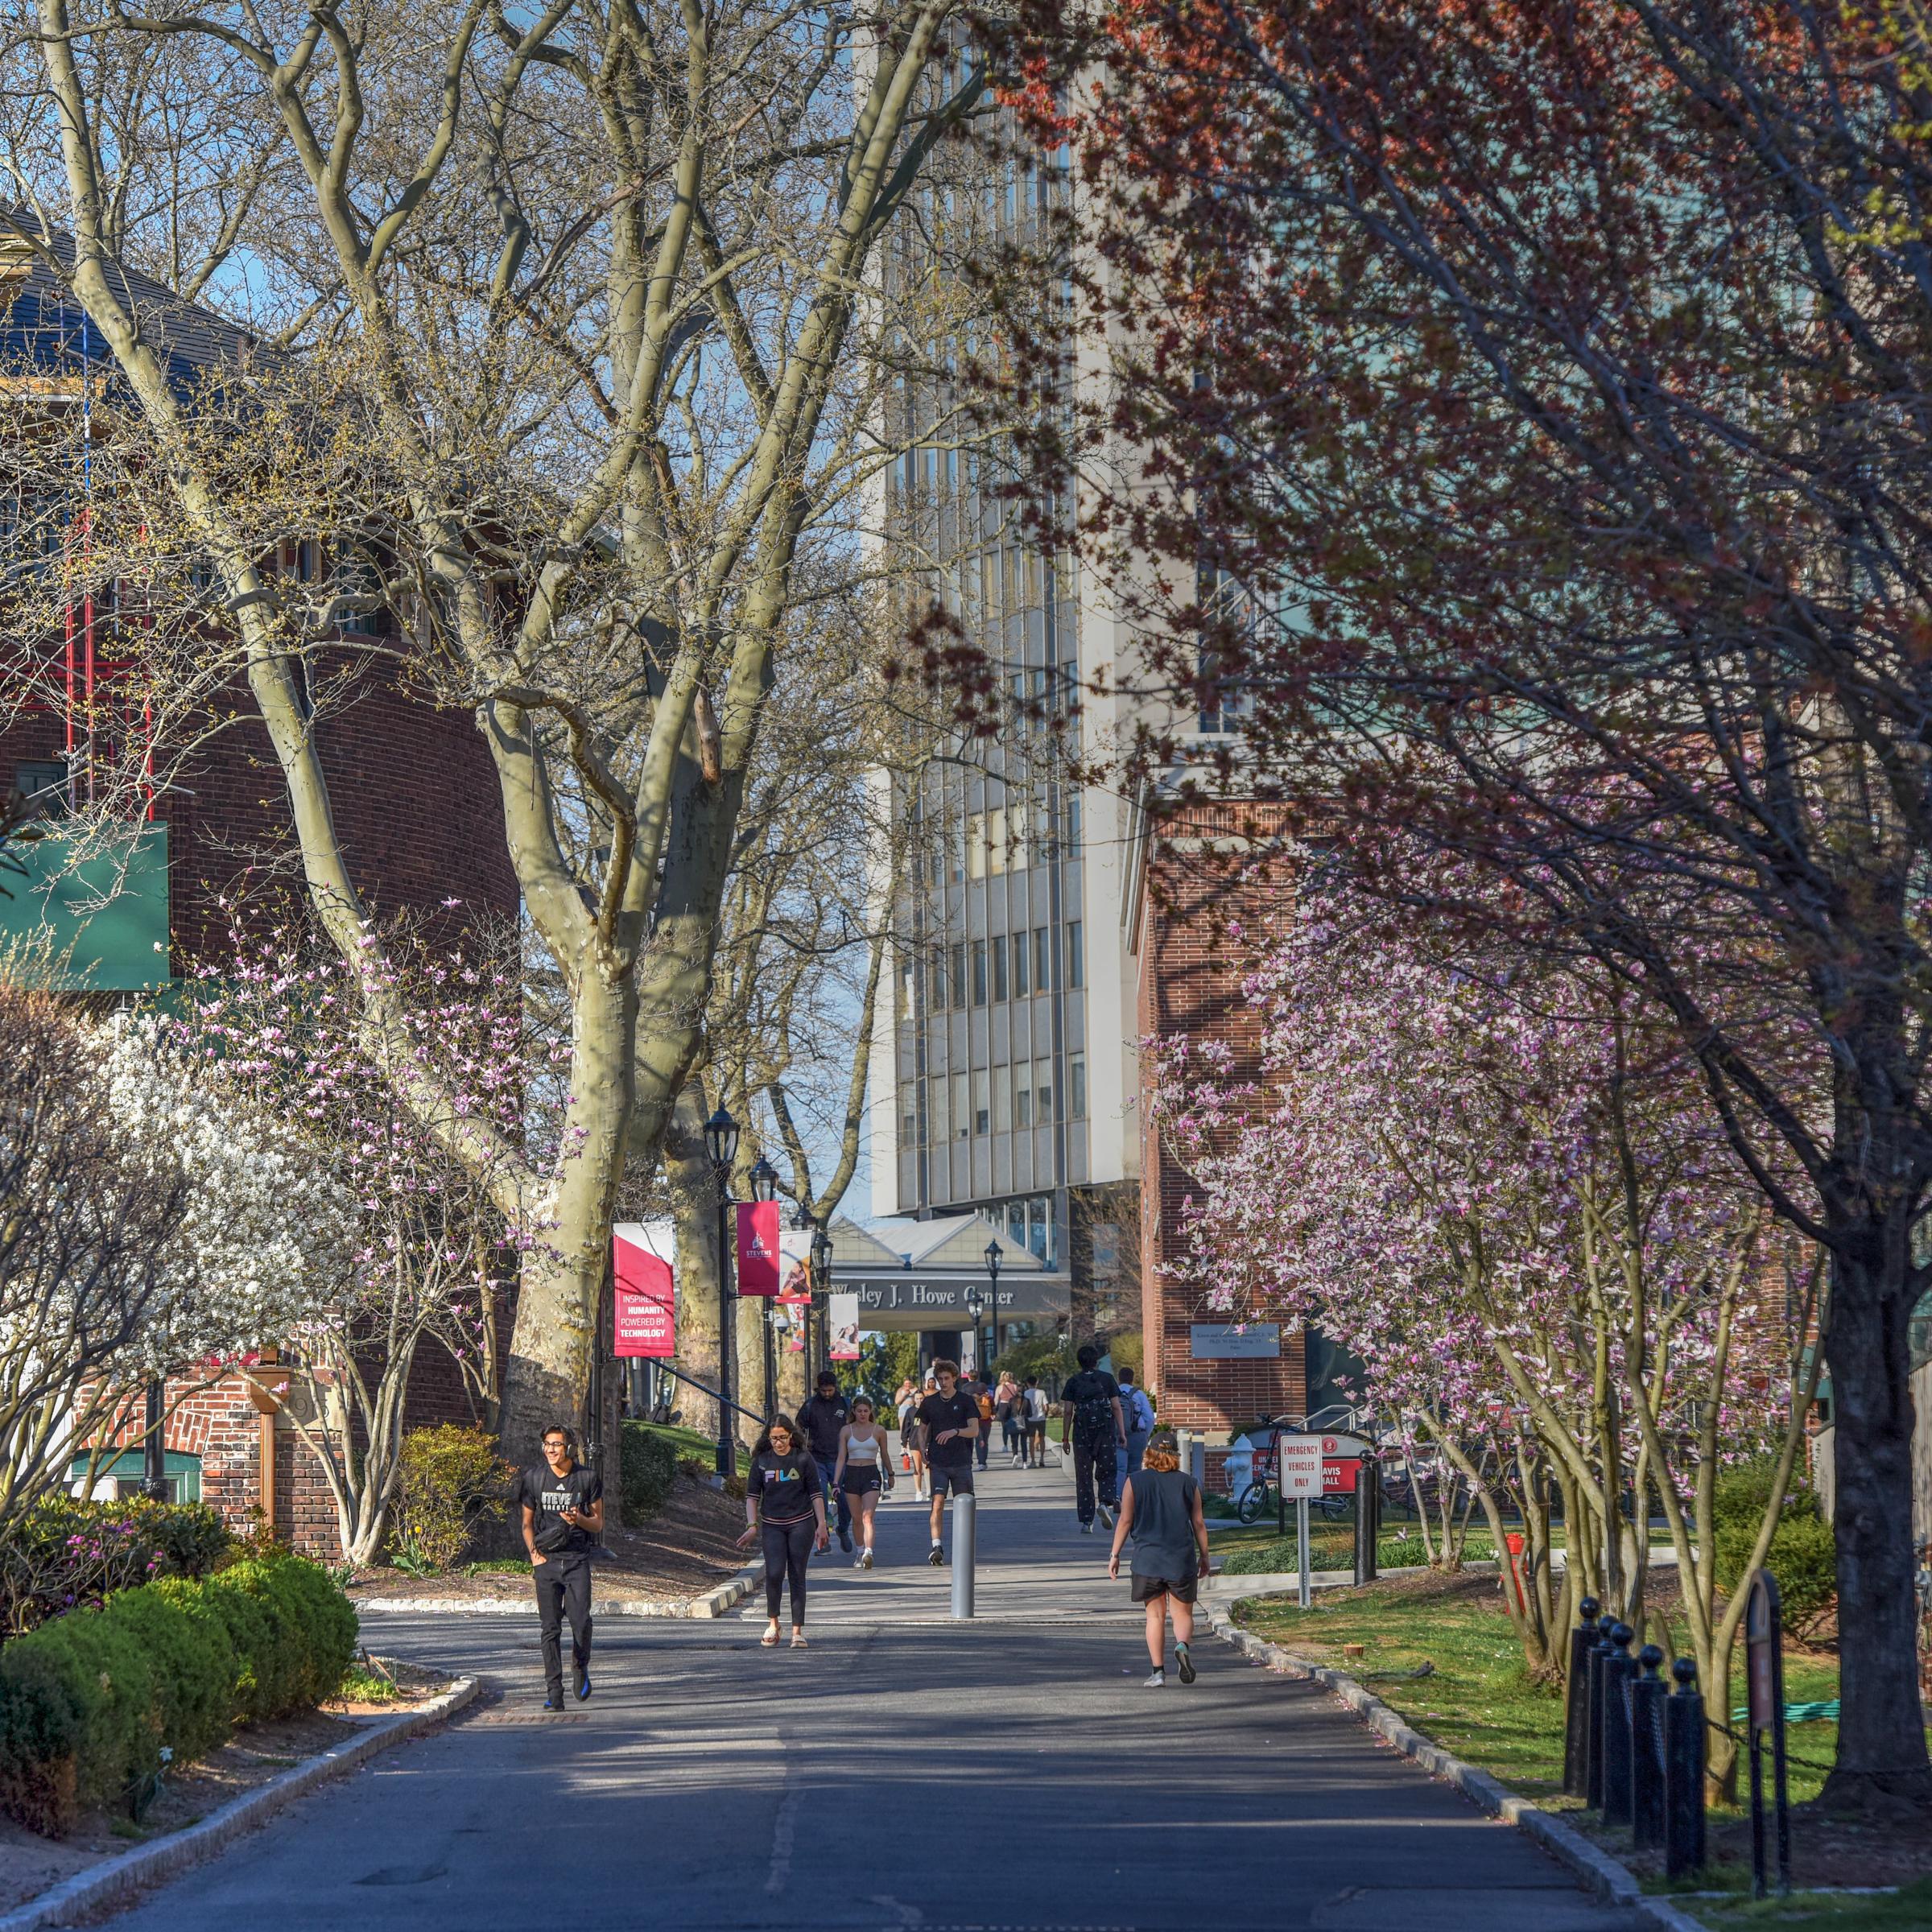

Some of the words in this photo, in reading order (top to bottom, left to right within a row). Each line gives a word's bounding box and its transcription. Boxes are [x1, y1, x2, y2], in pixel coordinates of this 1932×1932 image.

[623, 1294, 654, 1302] INSPIRED
[656, 1294, 666, 1302] BY
[890, 1285, 903, 1308] J.
[912, 1285, 956, 1304] Howe
[628, 1306, 666, 1315] HUMANITY
[621, 1318, 654, 1326] POWERED
[656, 1317, 666, 1326] BY
[620, 1329, 666, 1337] TECHNOLOGY
[1284, 1445, 1319, 1455] EMERGENCY
[1288, 1462, 1315, 1472] VEHICLES
[1323, 1467, 1341, 1476] AVIS
[765, 1468, 800, 1483] FILA
[1294, 1478, 1309, 1488] ONLY
